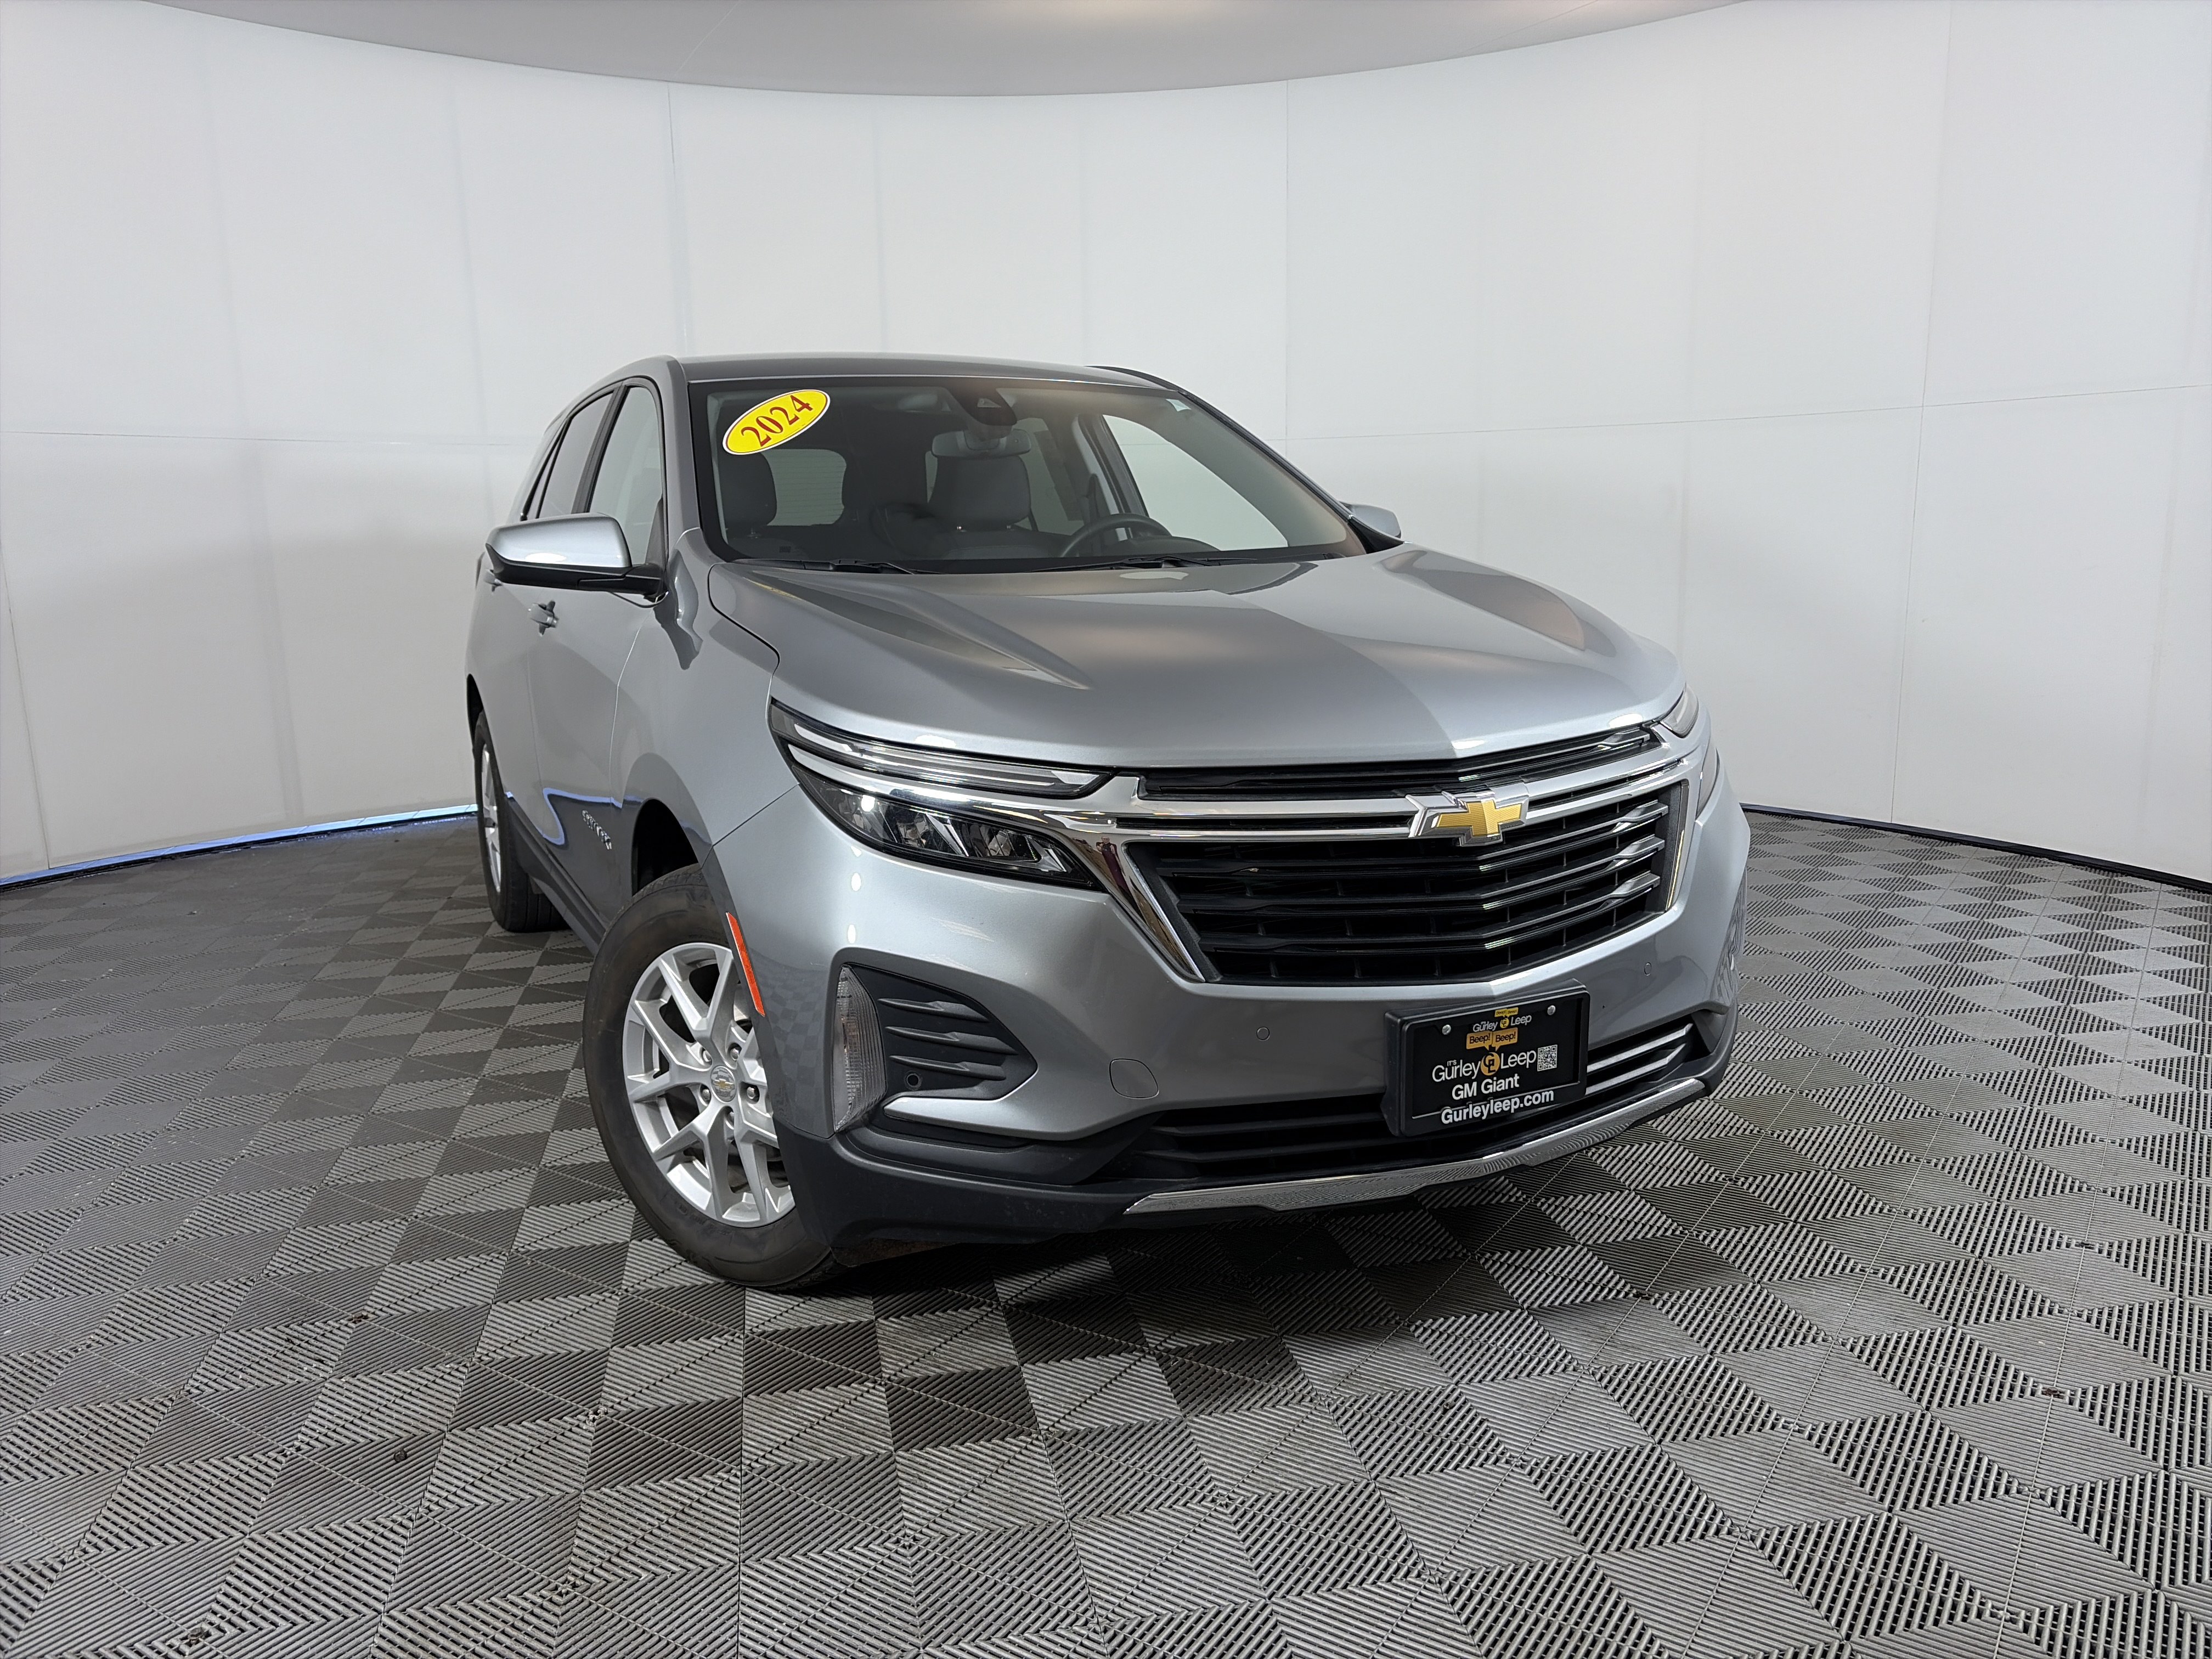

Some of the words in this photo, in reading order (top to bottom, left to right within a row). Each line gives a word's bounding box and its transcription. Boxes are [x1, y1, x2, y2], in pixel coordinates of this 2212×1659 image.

[741, 395, 813, 447] 2024
[1469, 1033, 1491, 1044] Beep!
[1495, 1031, 1516, 1042] Beep!
[1472, 1021, 1498, 1032] Gurley
[1510, 1015, 1532, 1026] Leep
[1432, 1059, 1481, 1082] Gurley
[1500, 1050, 1537, 1069] Leep
[1452, 1081, 1477, 1100] GM
[1481, 1073, 1520, 1094] Giant
[1441, 1090, 1554, 1125] Gurleyleep.com
